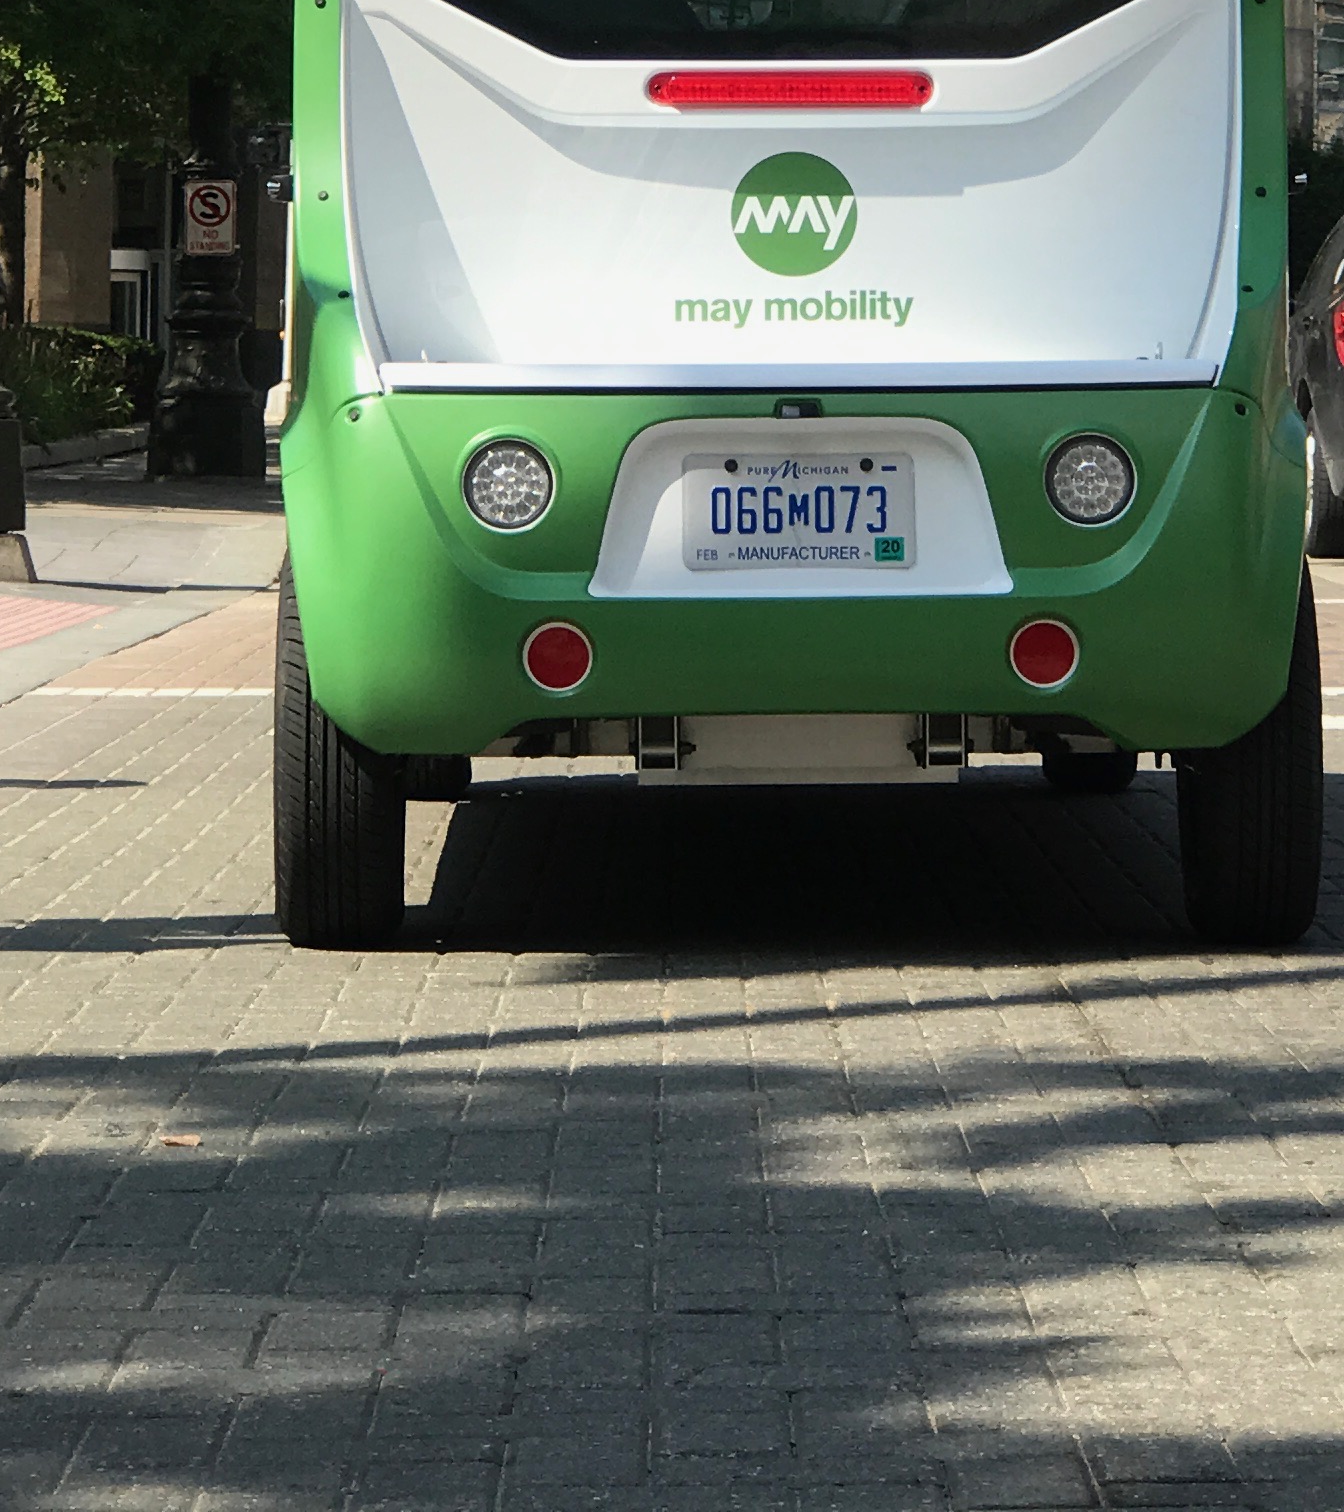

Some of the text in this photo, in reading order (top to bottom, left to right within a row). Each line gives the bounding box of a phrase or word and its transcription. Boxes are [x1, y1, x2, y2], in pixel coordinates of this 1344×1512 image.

[675, 290, 914, 329] may mobility
[747, 466, 777, 476] PURE
[711, 485, 887, 534] 066M073
[696, 540, 900, 561] FEB MANUFACTURER 20
